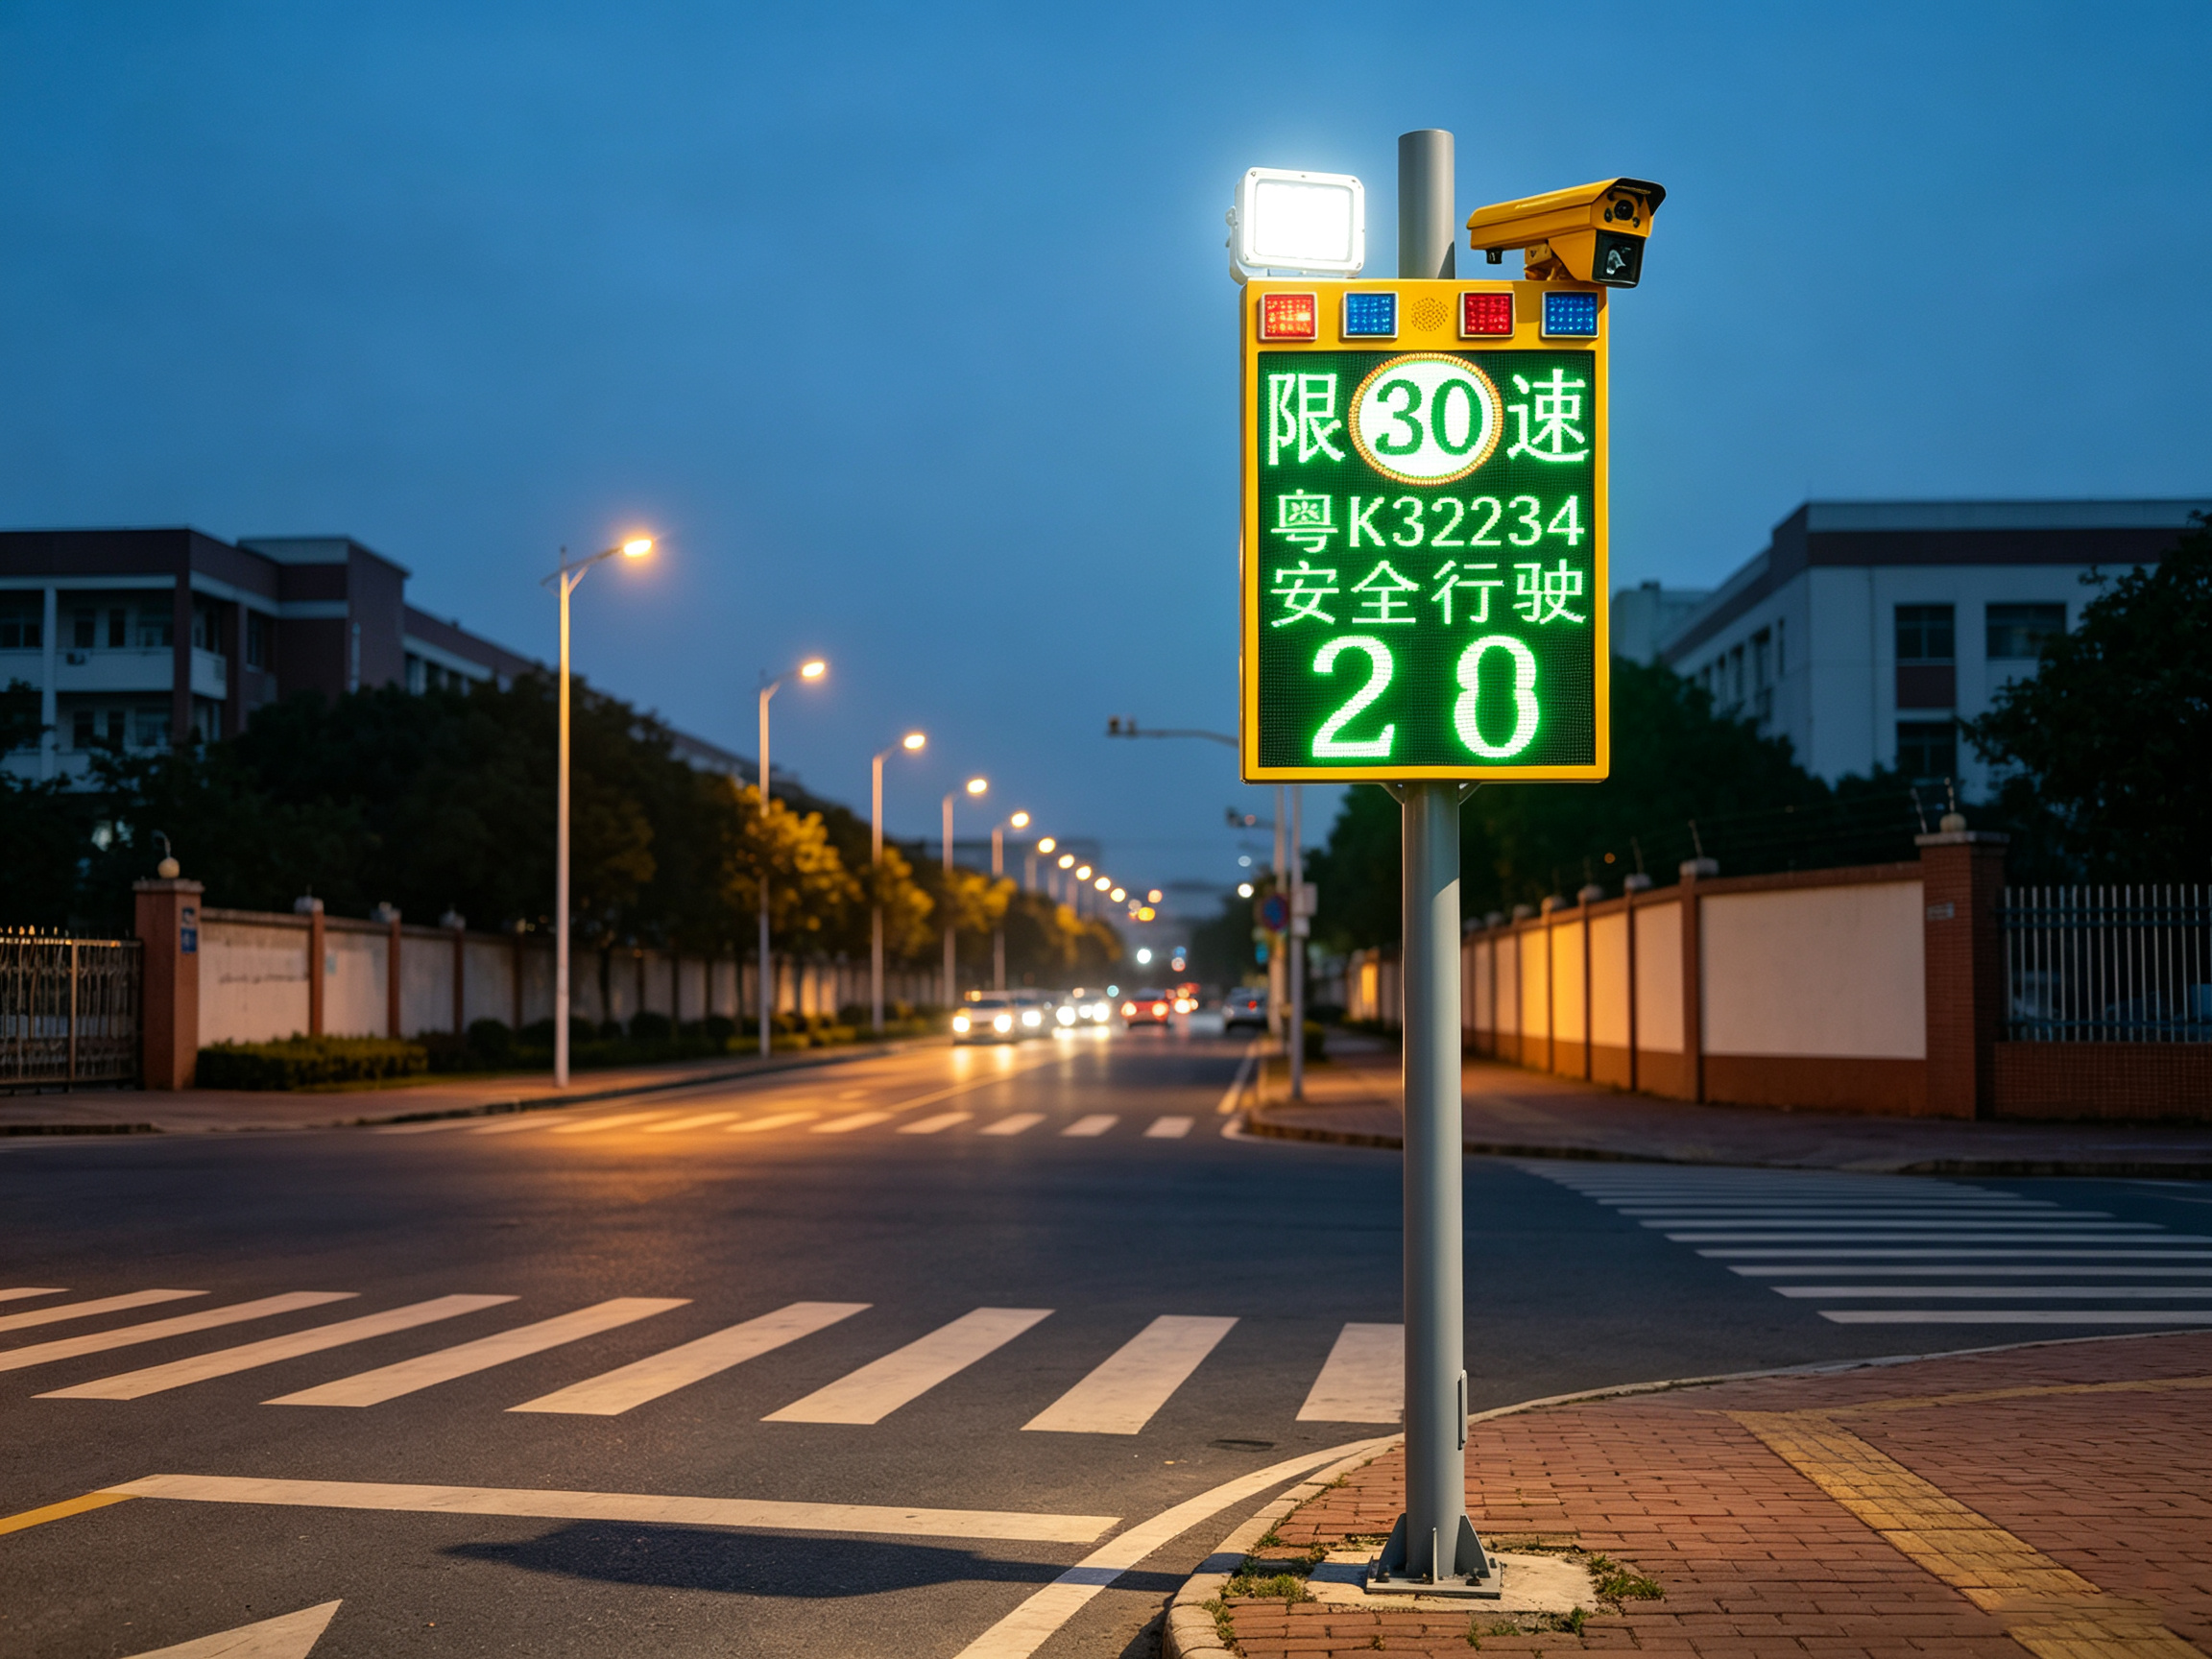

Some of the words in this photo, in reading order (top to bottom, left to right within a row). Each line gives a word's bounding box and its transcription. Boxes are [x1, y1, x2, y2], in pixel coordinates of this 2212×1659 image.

[1268, 373, 1346, 466] 限
[1374, 378, 1483, 456] 30
[1506, 368, 1590, 463] 速
[1270, 559, 1586, 628] 安全行驶
